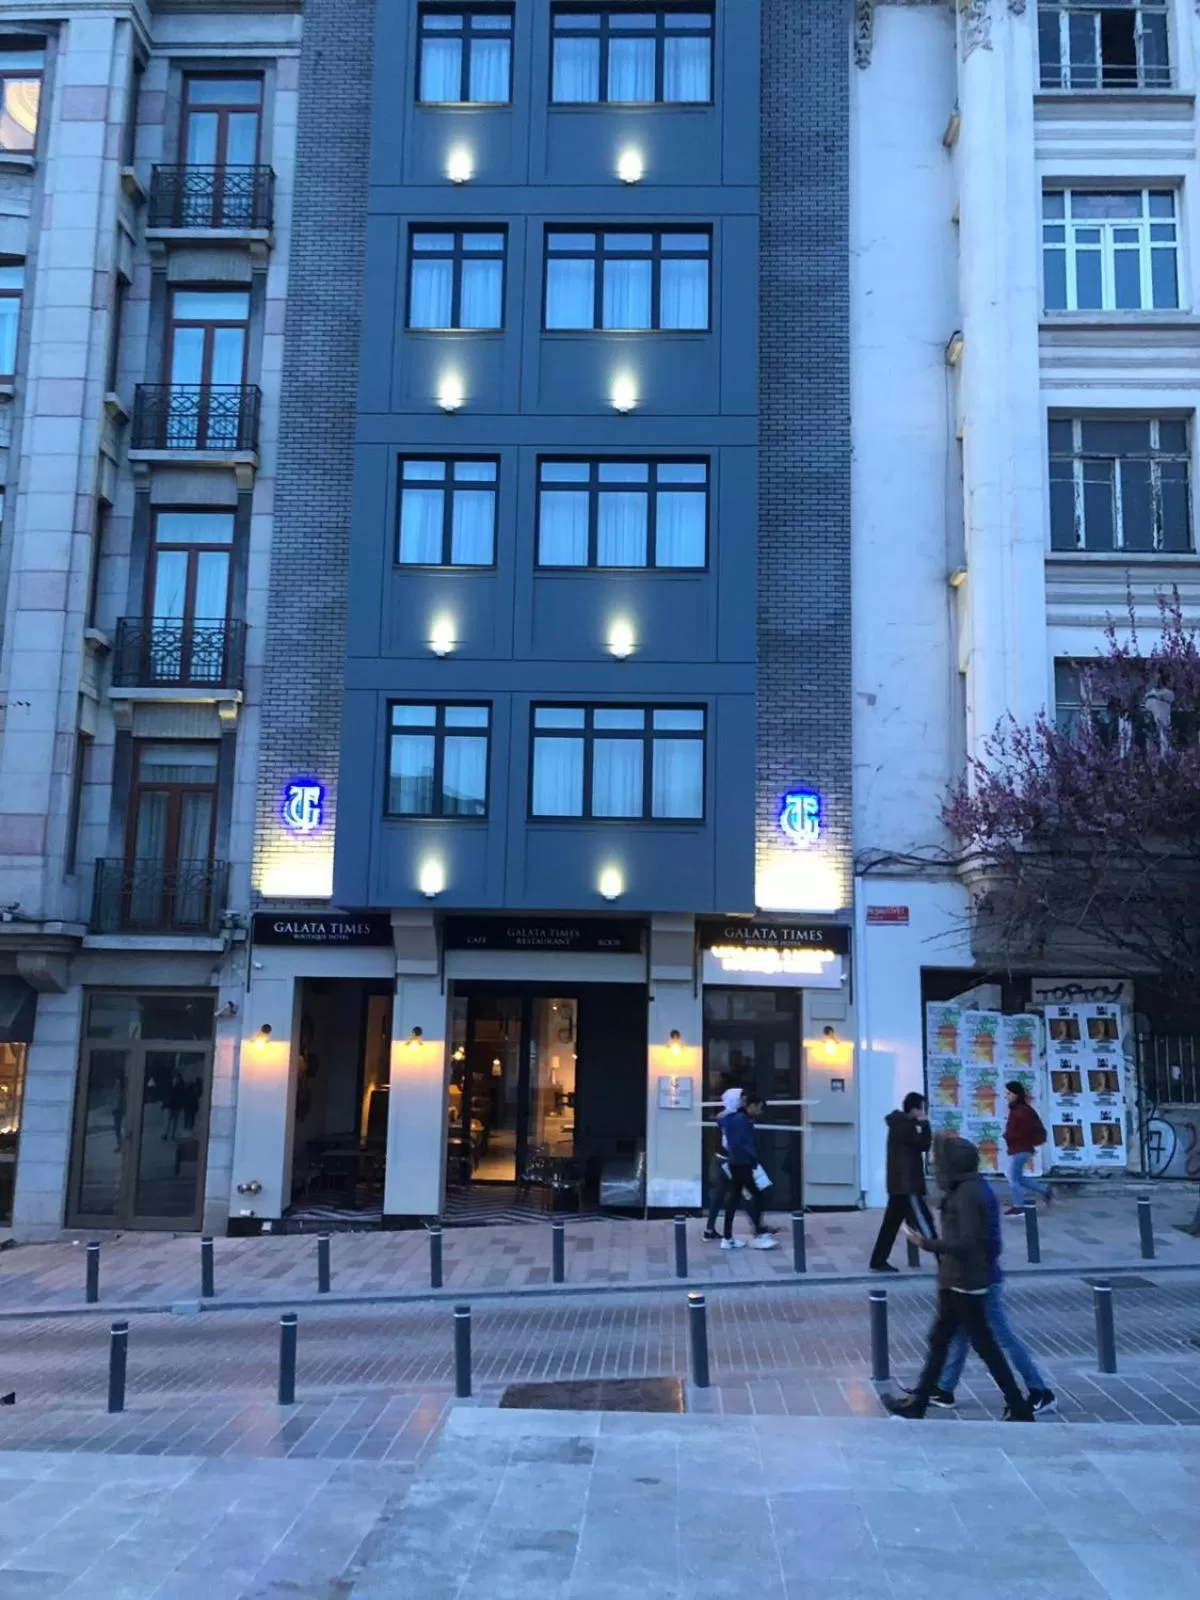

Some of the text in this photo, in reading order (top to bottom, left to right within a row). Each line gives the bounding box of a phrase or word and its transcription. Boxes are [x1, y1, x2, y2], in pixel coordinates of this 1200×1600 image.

[273, 921, 371, 935] GALATA TIMES
[506, 927, 581, 939] GALATA TIMES
[724, 927, 824, 941] GALATA TIMES
